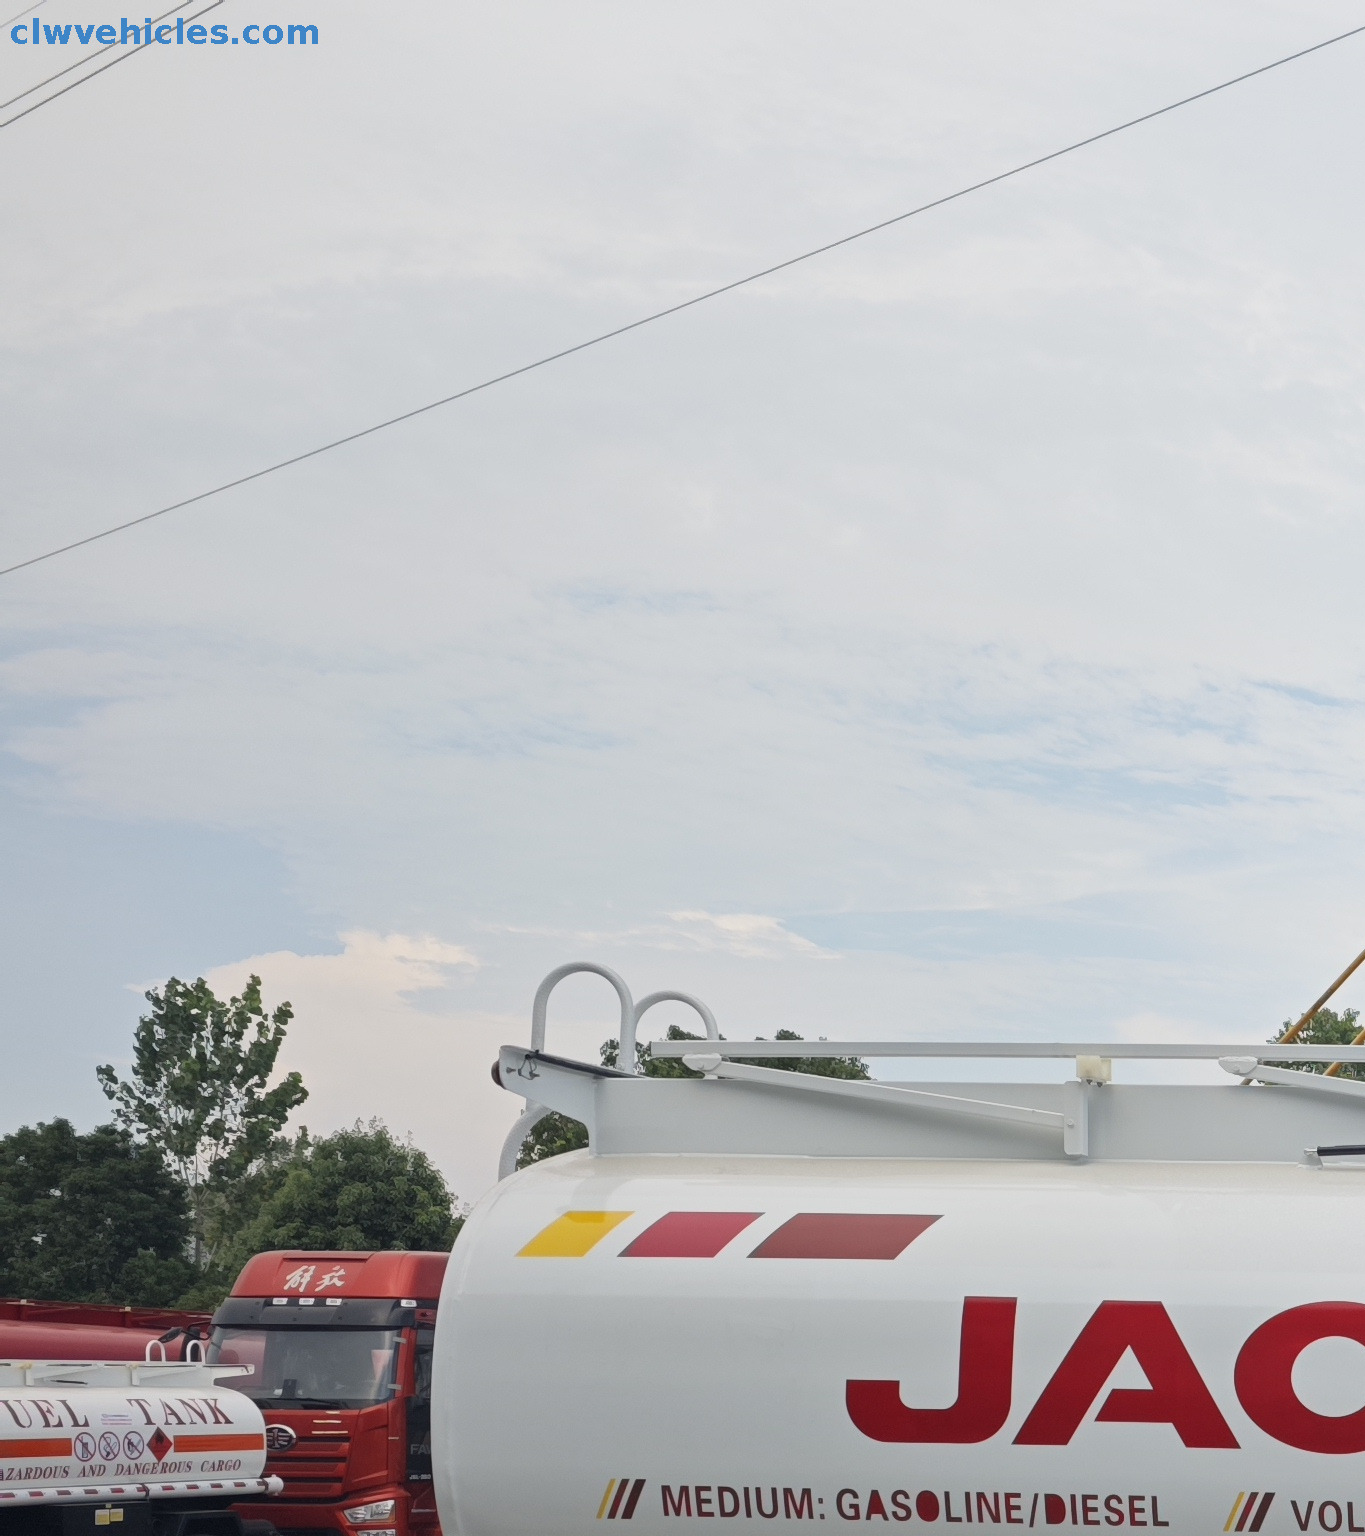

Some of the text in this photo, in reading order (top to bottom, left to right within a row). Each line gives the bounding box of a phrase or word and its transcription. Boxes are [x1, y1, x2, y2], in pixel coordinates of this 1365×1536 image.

[283, 1265, 346, 1292] 解放
[0, 1399, 90, 1428] UEL
[127, 1398, 234, 1426] TANK
[78, 1463, 107, 1478] AND
[114, 1461, 192, 1477] DANGEROUS
[200, 1459, 242, 1473] CARGO
[660, 1484, 1170, 1529] MEDIUM: GASOLINE/DIESEL
